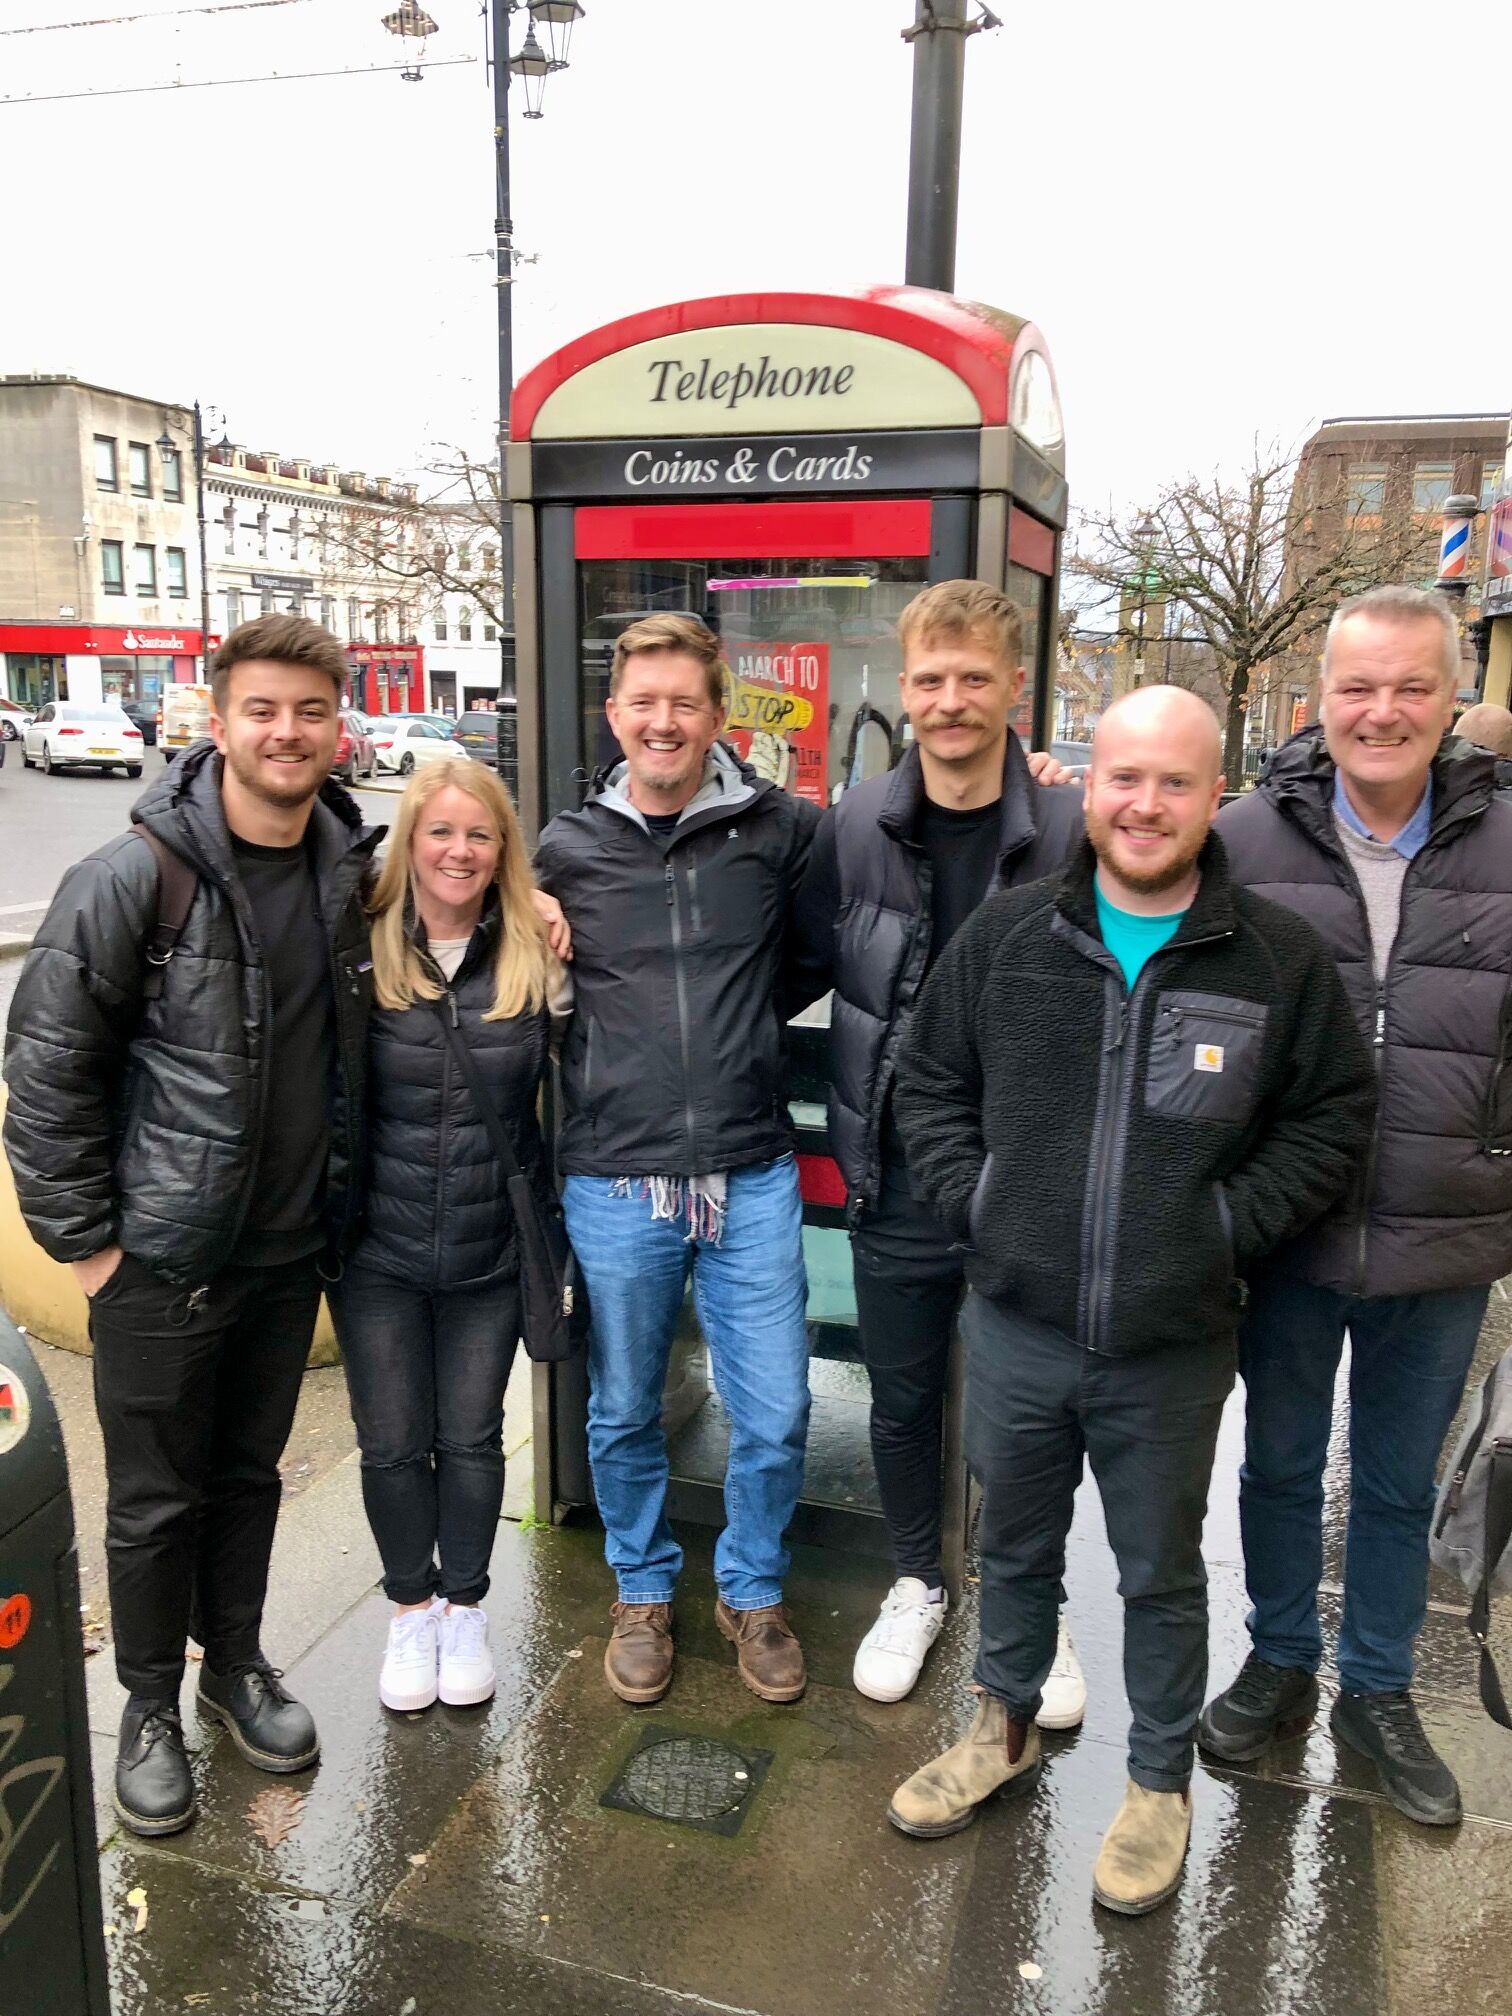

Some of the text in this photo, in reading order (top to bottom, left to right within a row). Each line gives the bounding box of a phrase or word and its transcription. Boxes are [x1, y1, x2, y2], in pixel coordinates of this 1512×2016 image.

[648, 356, 855, 409] Telephone
[624, 445, 873, 485] Coins & Cards
[138, 634, 185, 649] Santander
[738, 655, 819, 691] MARCH TO
[737, 693, 795, 724] STOP
